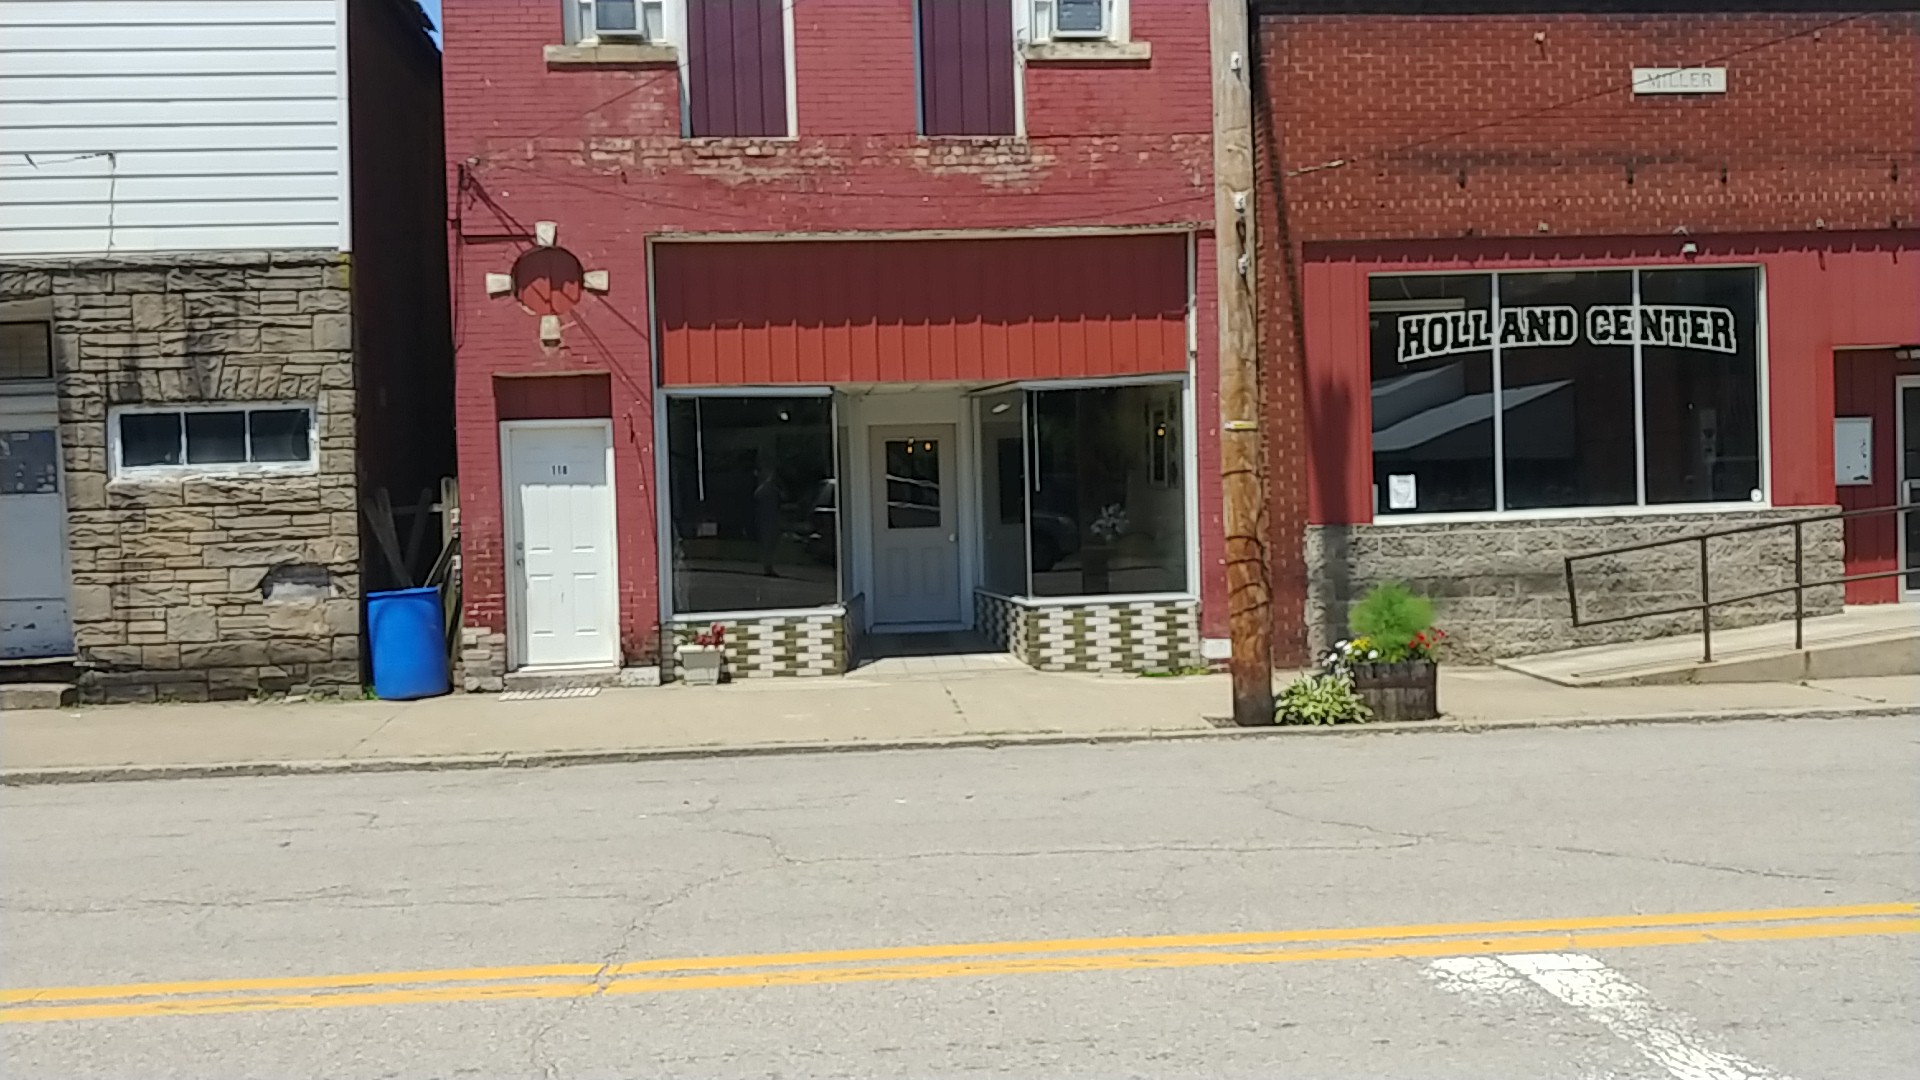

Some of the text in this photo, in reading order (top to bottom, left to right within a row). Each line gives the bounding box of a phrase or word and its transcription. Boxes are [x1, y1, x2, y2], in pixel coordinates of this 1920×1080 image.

[1647, 72, 1713, 89] MILLER
[1397, 304, 1737, 363] HOLLAND CENTER
